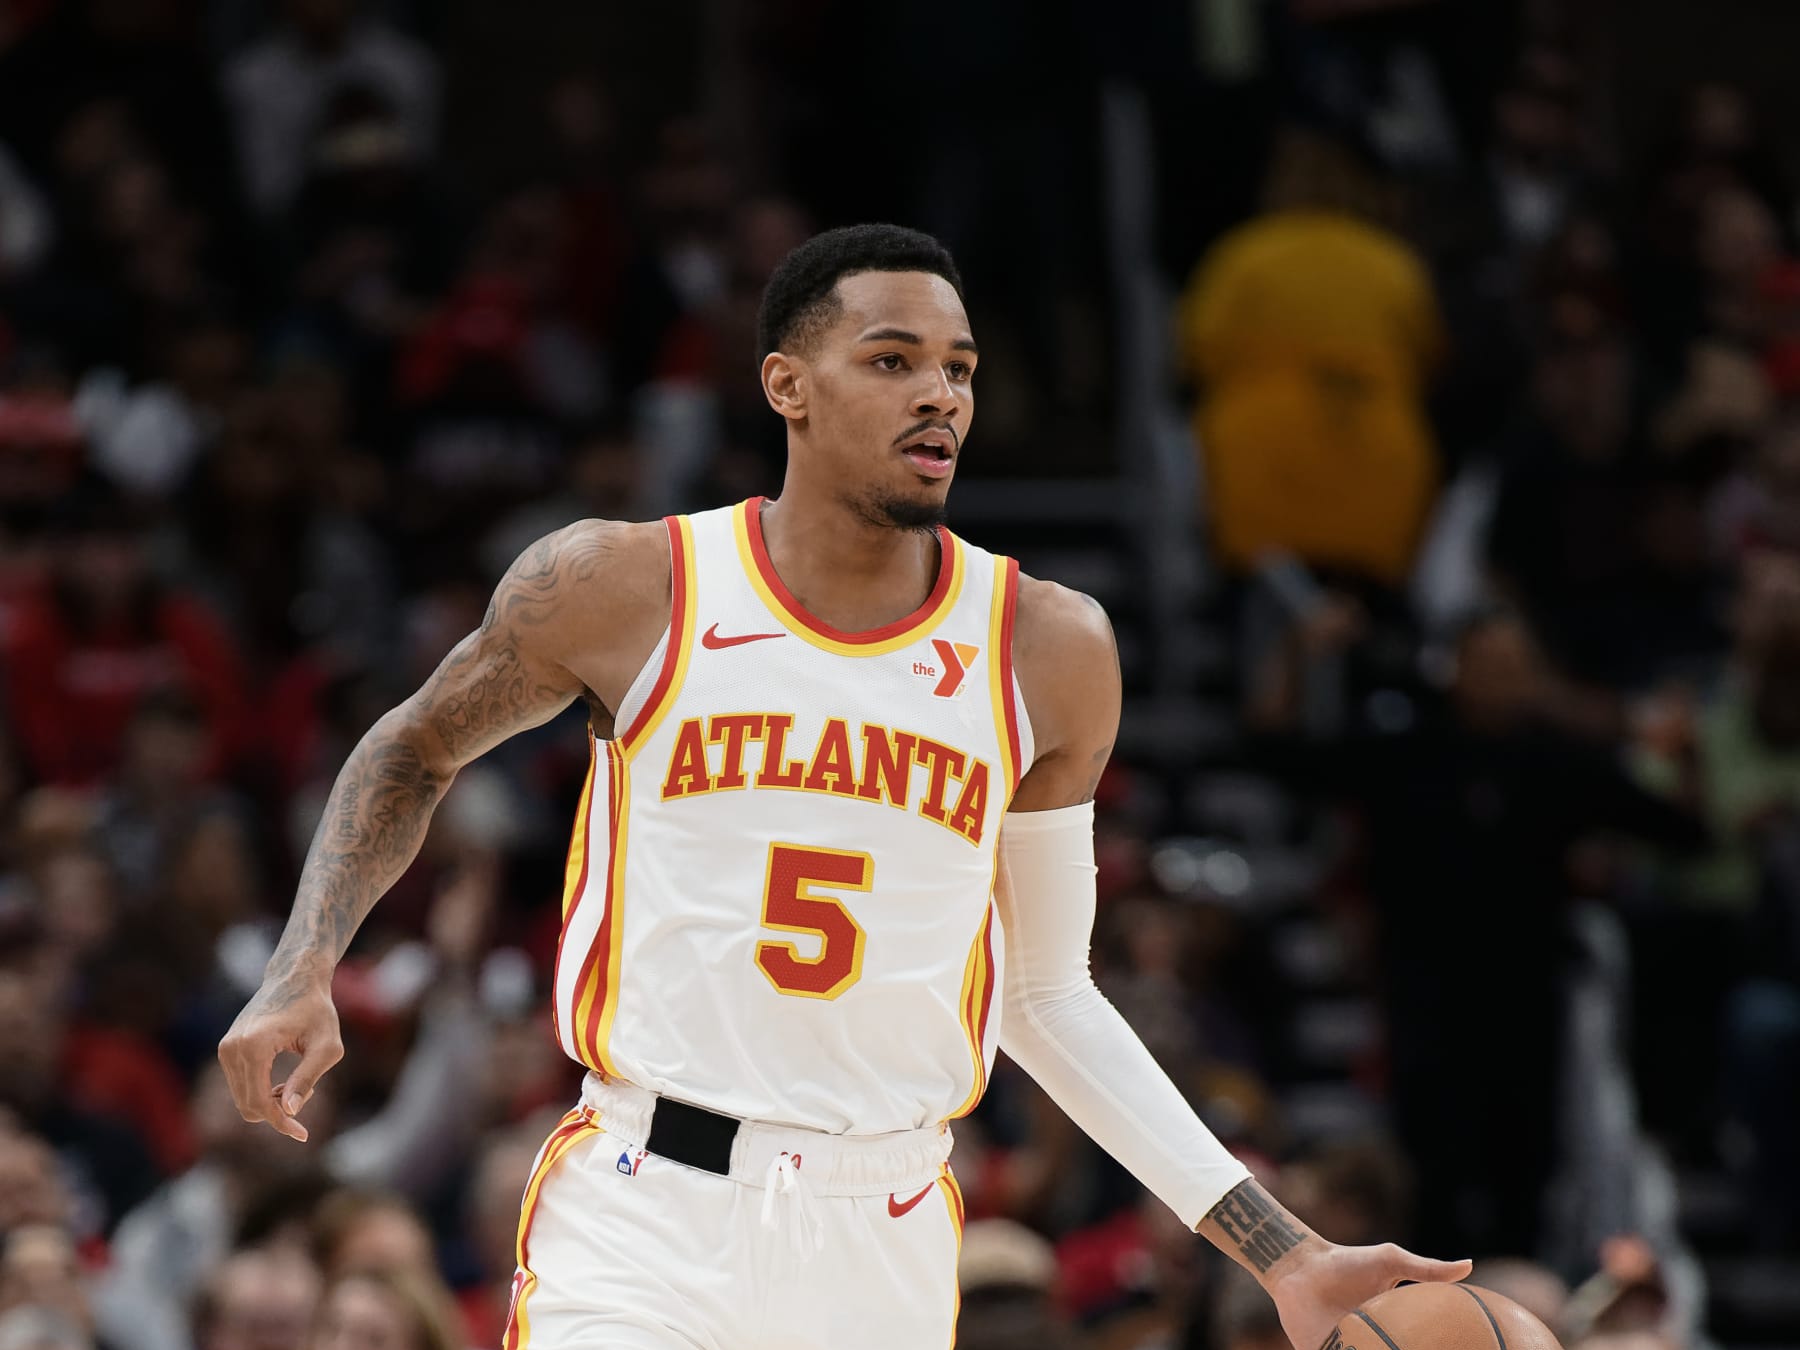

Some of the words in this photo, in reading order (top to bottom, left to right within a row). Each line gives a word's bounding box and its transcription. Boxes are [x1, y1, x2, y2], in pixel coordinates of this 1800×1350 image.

[913, 662, 936, 677] the
[660, 713, 990, 848] ATLANTA
[754, 841, 875, 1001] 5
